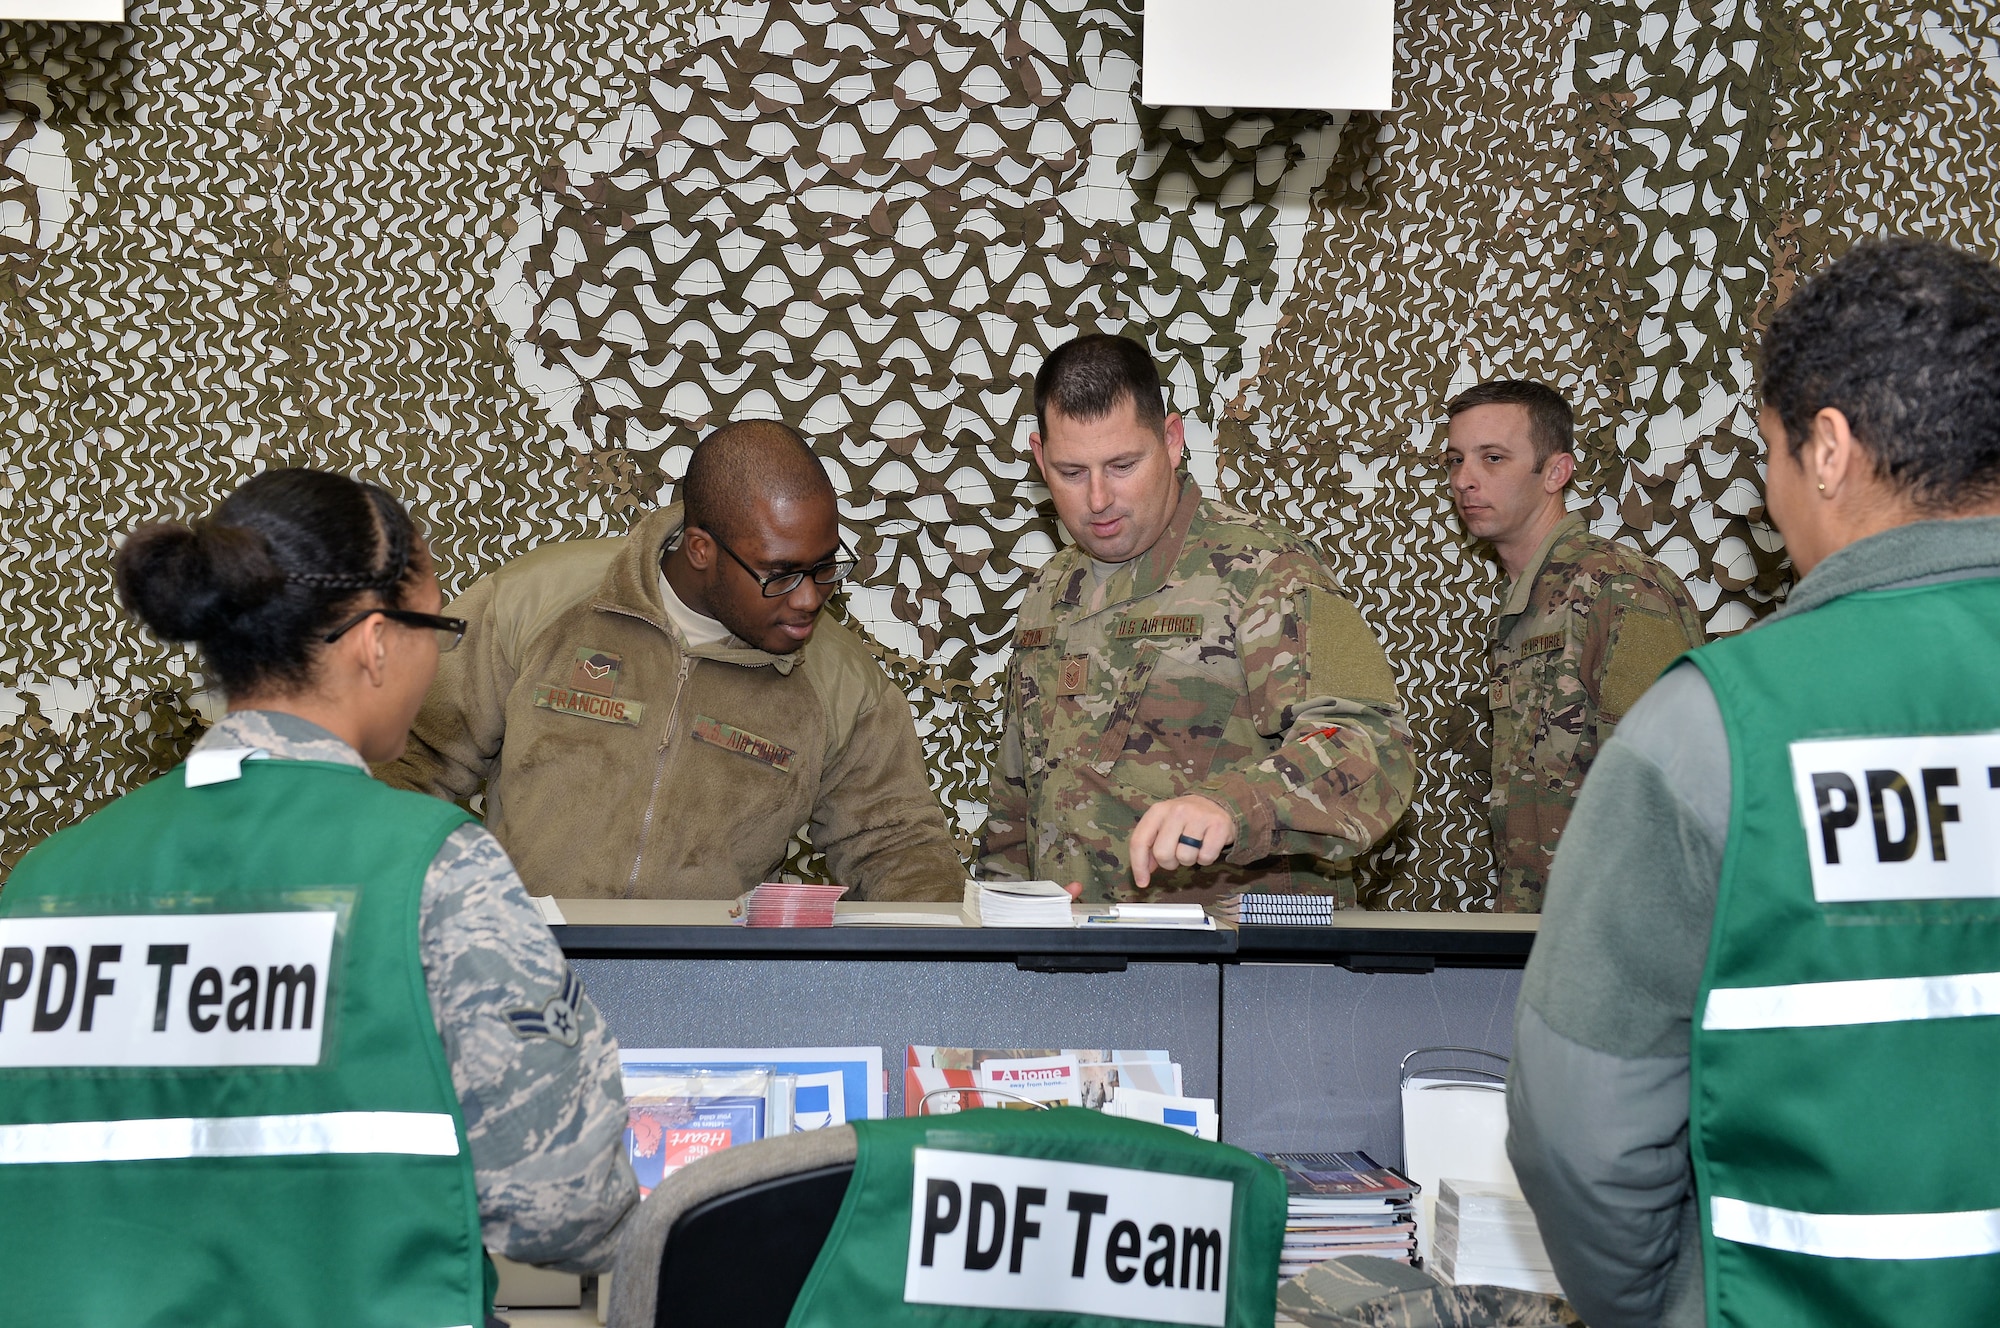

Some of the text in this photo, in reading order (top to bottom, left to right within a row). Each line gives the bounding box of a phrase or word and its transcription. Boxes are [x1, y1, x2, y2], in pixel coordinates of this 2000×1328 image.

[1140, 618, 1158, 633] AIR
[1161, 616, 1197, 632] FORCE
[548, 688, 626, 719] FRANCOIS
[726, 730, 750, 752] AIR
[751, 737, 791, 767] FORCE
[1811, 767, 1960, 864] PDF
[0, 944, 316, 1033] PDF Team
[1002, 1069, 1062, 1080] A home
[670, 1132, 725, 1146] Heart
[689, 1146, 709, 1156] the
[920, 1178, 1222, 1292] PDF Team
